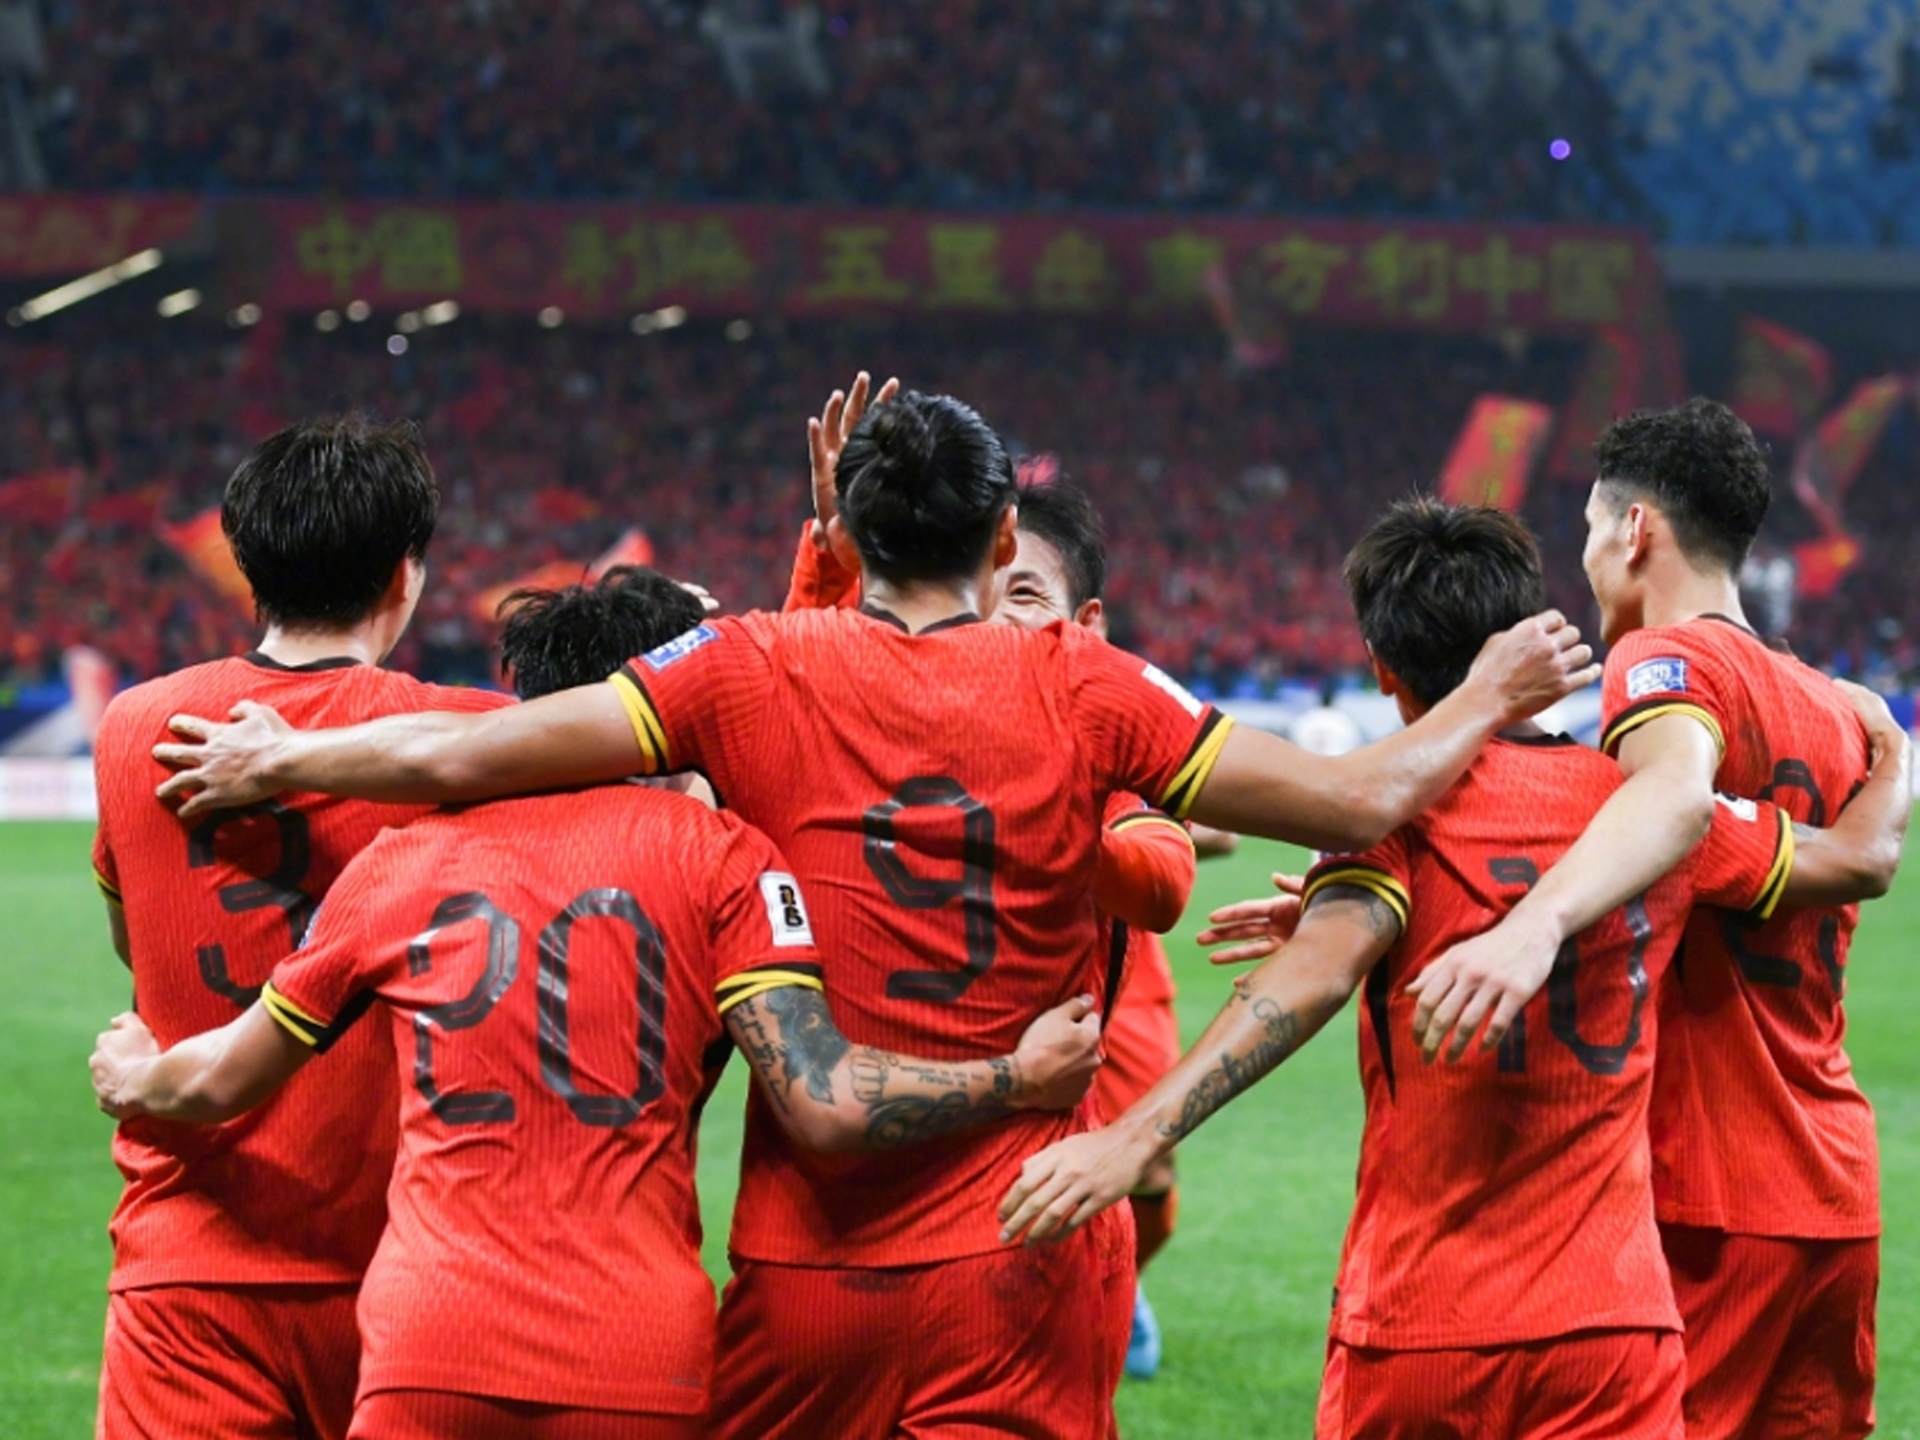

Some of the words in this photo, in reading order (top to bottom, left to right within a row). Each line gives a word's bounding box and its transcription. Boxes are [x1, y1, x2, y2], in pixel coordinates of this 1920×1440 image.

[188, 797, 318, 1012] 3
[861, 776, 997, 1004] 9
[406, 887, 666, 1127] 20
